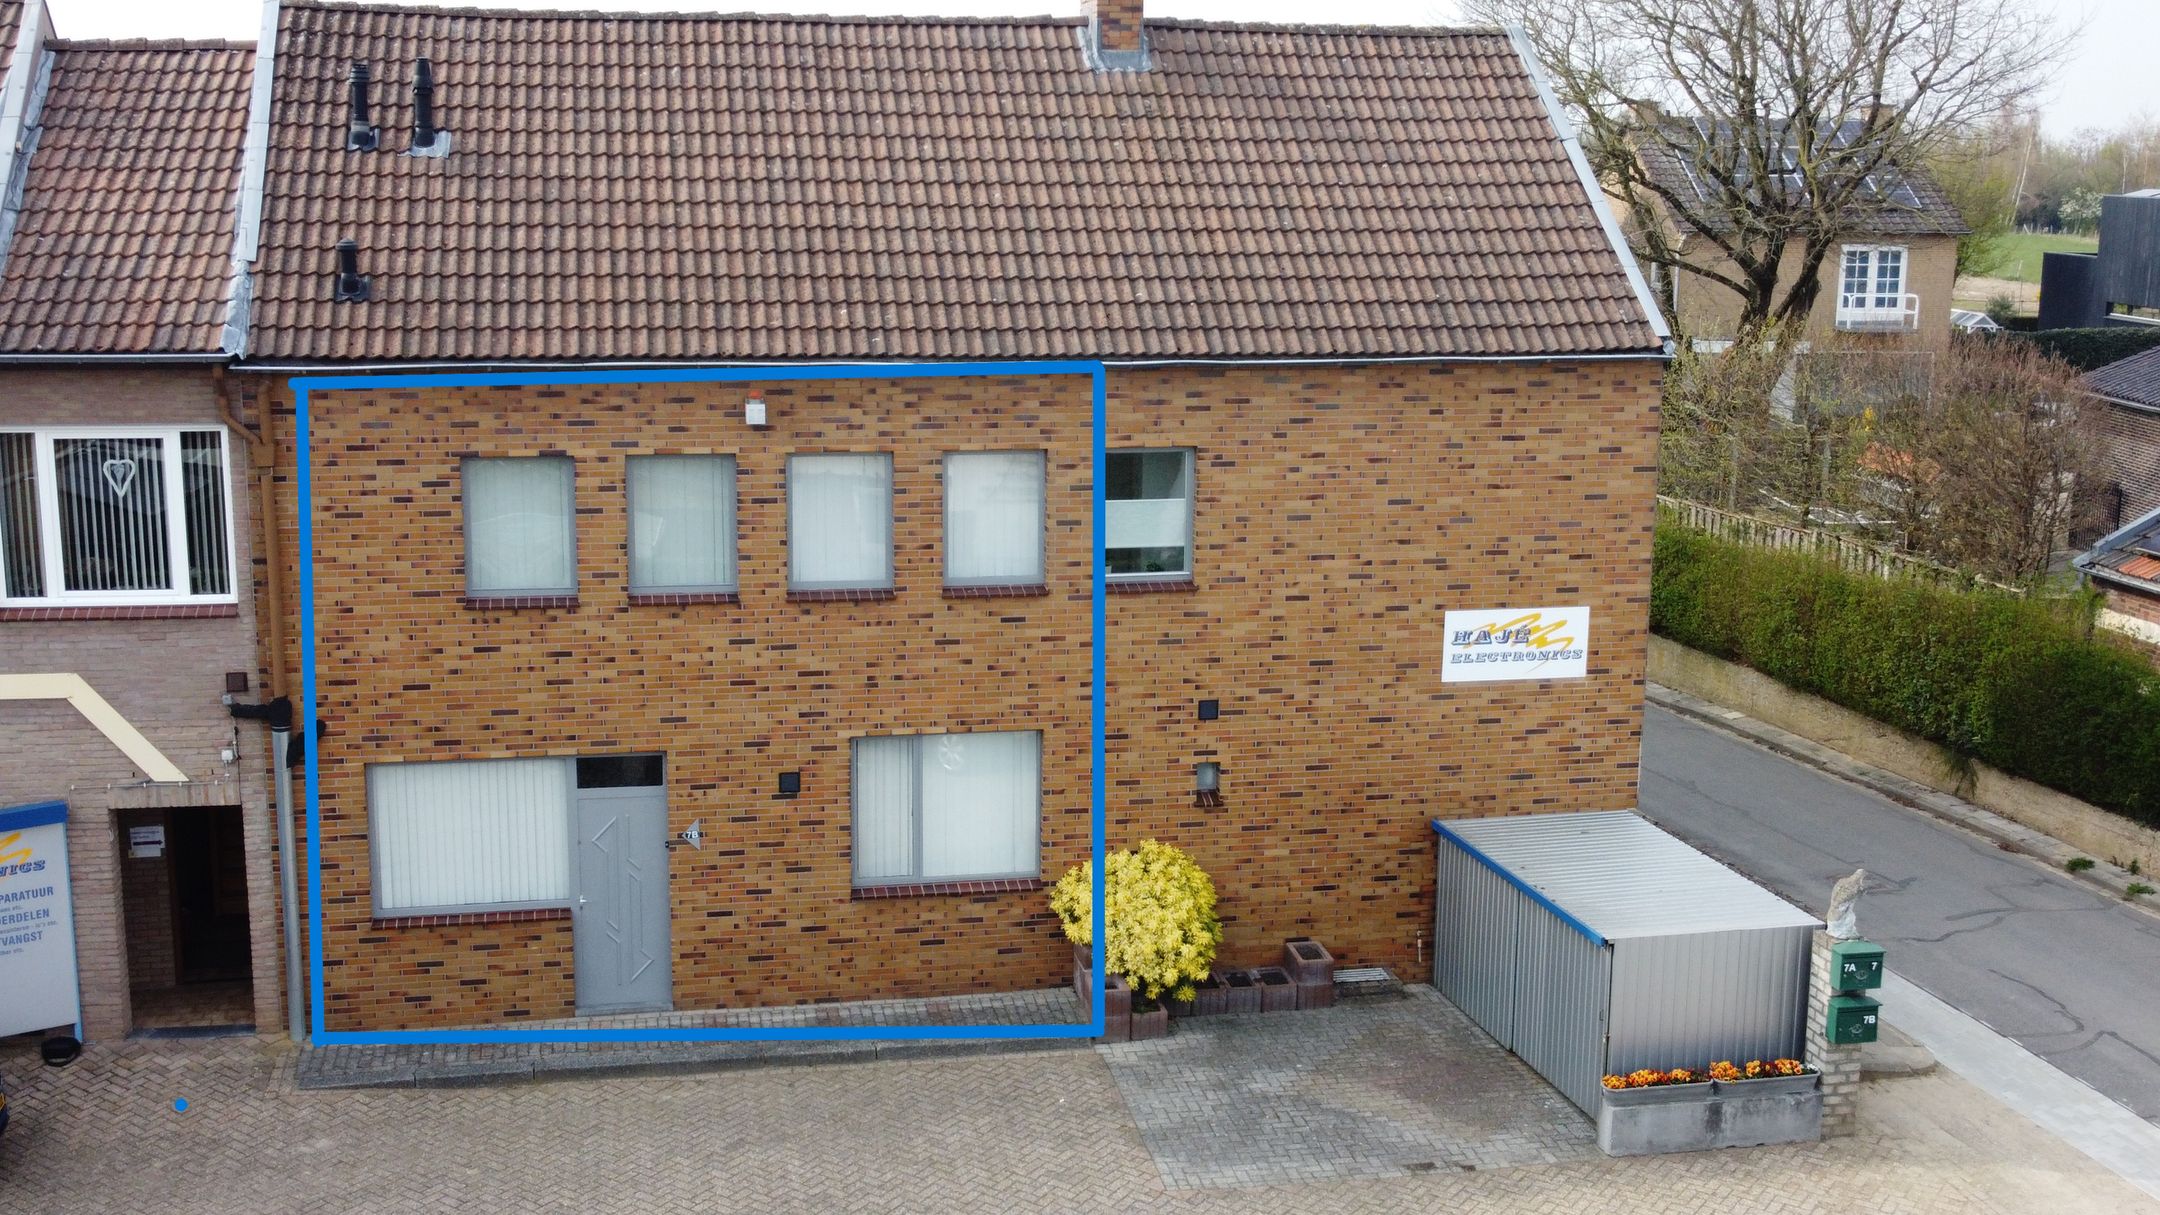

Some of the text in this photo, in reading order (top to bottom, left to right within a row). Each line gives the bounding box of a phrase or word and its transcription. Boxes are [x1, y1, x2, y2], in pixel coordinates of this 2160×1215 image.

[1451, 649, 1583, 664] ELECTRONICS
[686, 830, 699, 839] 7B
[0, 908, 49, 925] ERDELEN
[1843, 963, 1857, 973] 7A
[1871, 961, 1878, 971] 7
[1863, 1015, 1876, 1024] 7B
